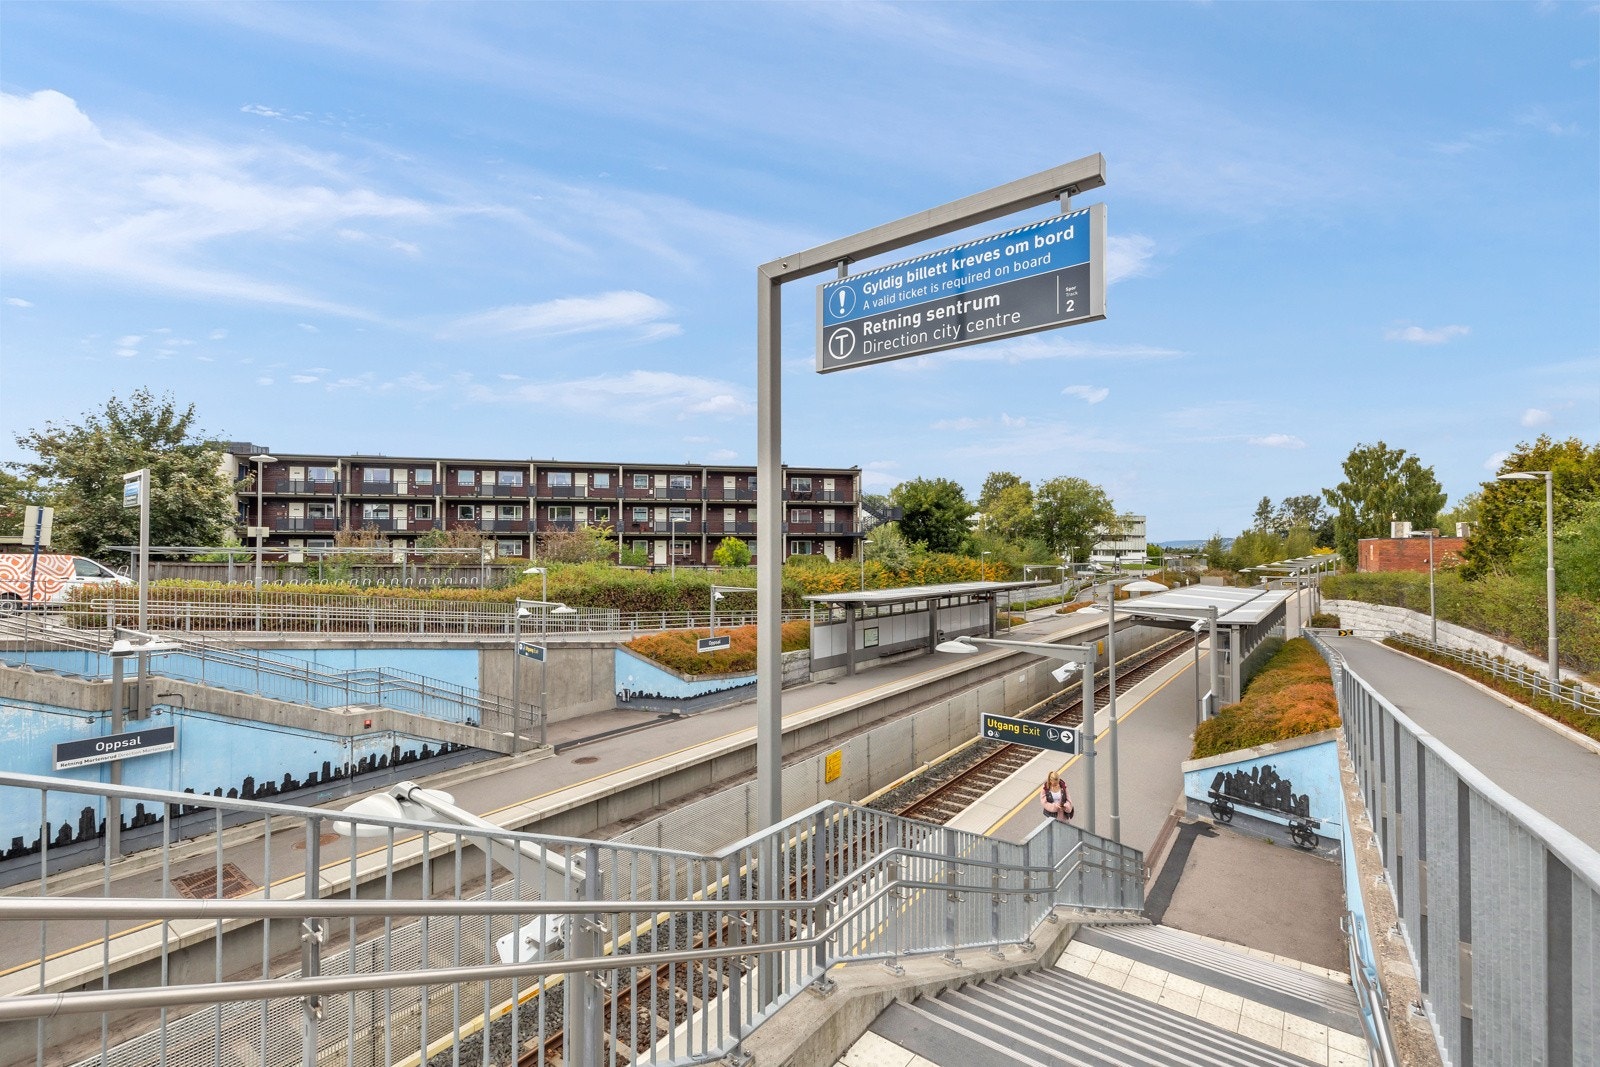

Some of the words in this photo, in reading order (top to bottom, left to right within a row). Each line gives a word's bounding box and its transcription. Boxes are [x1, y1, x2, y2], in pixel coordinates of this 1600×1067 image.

[863, 275, 903, 295] Gyldig
[906, 261, 948, 284] billett
[952, 249, 1001, 271] kreves
[1005, 240, 1029, 256] om
[1034, 225, 1074, 249] bord
[863, 300, 870, 310] A
[872, 293, 896, 308] valid
[898, 283, 928, 299] ticket
[930, 282, 939, 293] is
[942, 268, 991, 290] required
[994, 265, 1010, 277] on
[1013, 252, 1051, 272] board
[863, 313, 921, 336] Retning
[926, 294, 1000, 321] sentrum
[1066, 299, 1075, 312] 2
[863, 331, 928, 355] Direction
[933, 323, 961, 340] city
[966, 311, 1021, 333] centre
[95, 736, 141, 752] Oppsal
[987, 719, 1020, 734] Utgang
[1022, 725, 1040, 736] Exit
